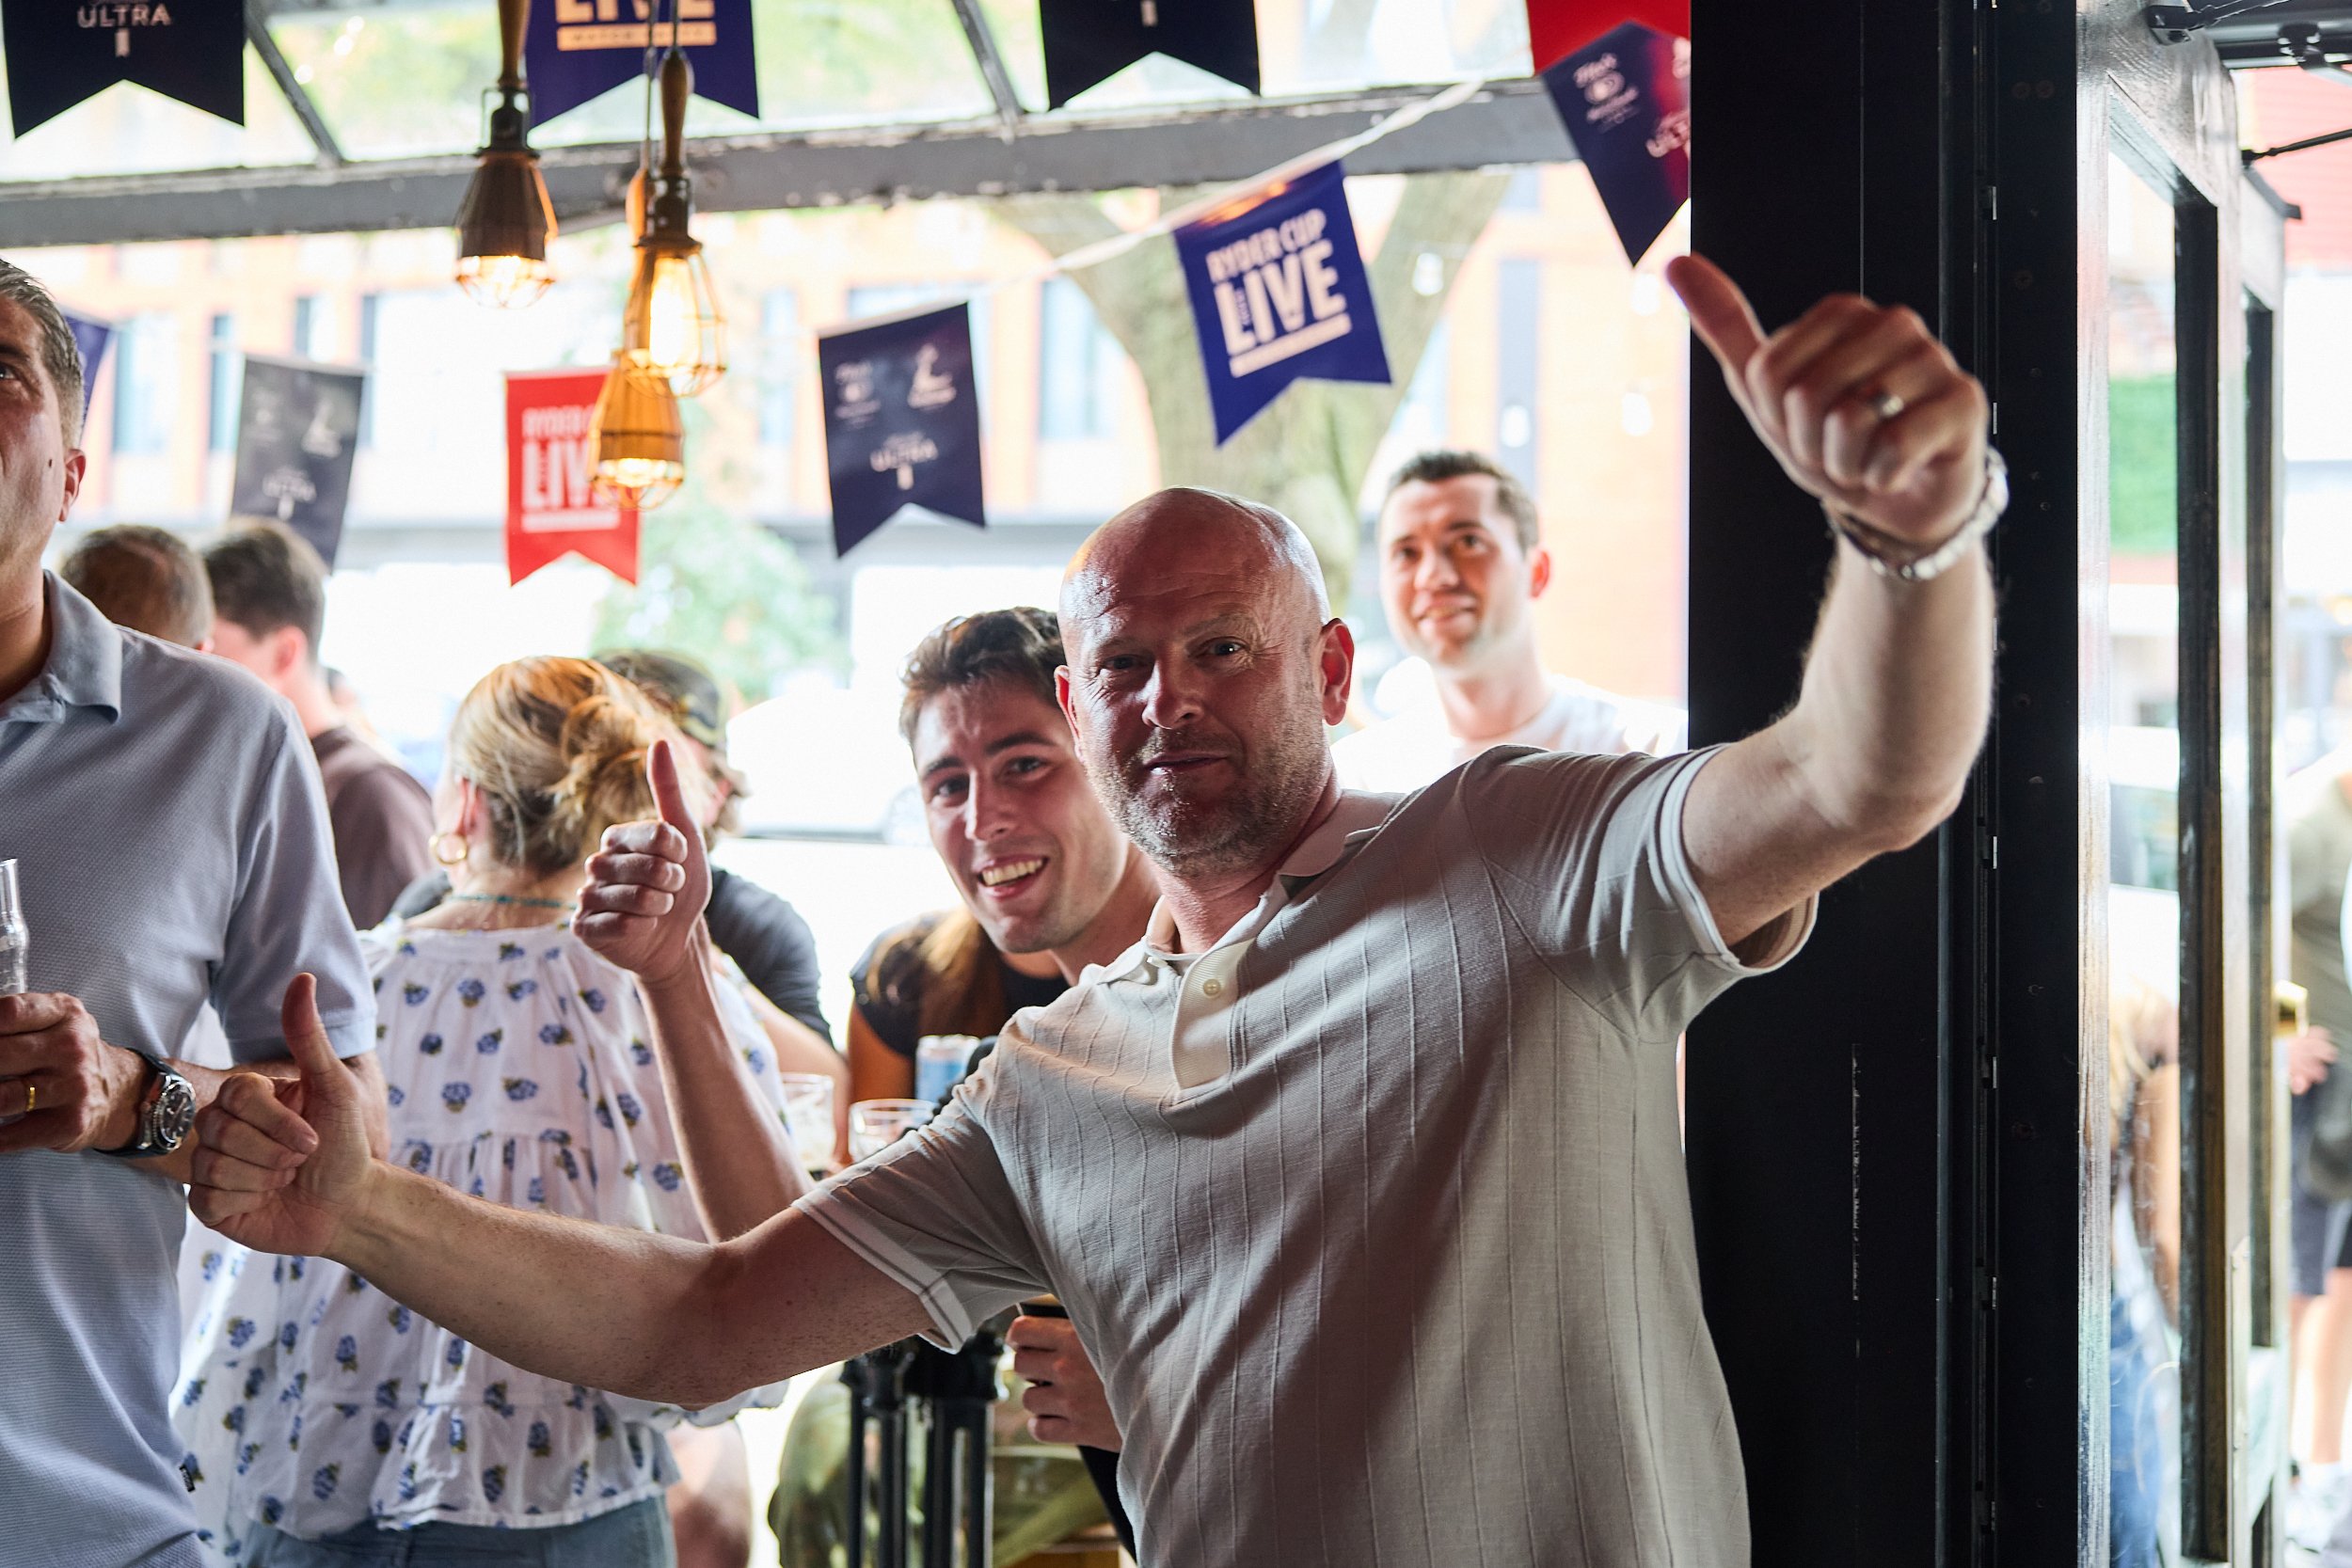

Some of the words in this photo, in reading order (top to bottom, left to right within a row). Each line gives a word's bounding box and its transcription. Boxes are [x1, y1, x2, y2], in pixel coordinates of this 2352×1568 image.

[77, 3, 171, 28] ULTRA
[1205, 227, 1283, 284] RYDER
[1279, 208, 1327, 253] CUP
[1214, 238, 1347, 356] LIVE
